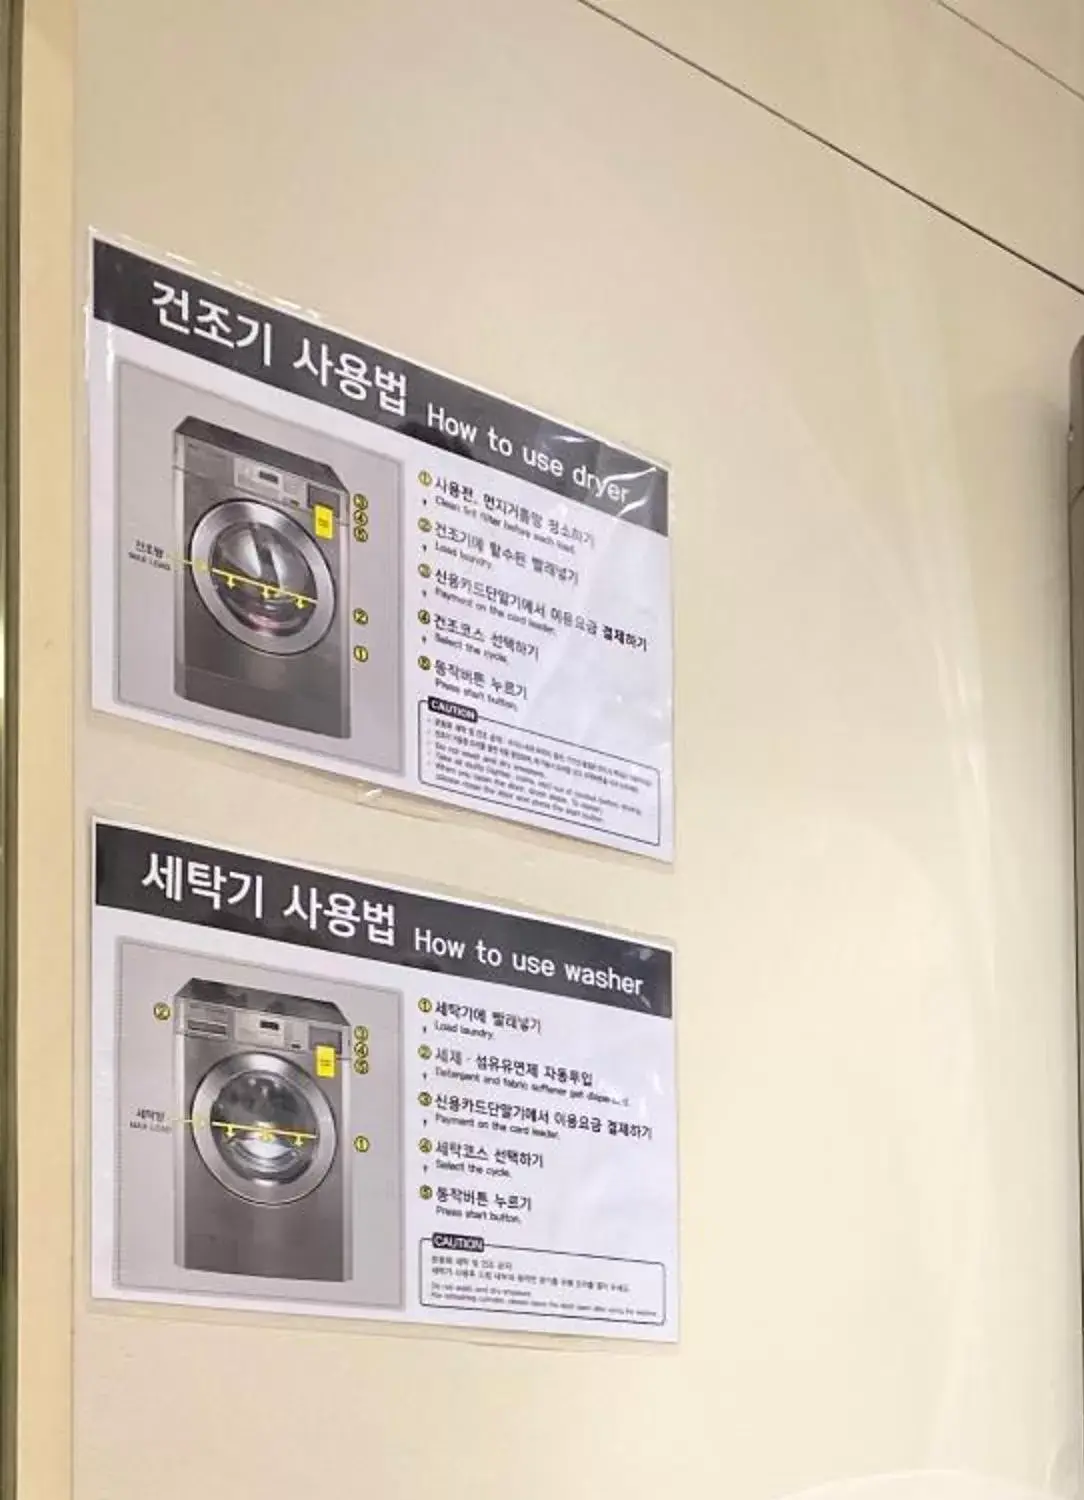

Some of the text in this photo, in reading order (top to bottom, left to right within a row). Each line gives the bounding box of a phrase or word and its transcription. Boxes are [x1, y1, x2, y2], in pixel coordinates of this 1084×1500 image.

[152, 281, 630, 503] 건조기 사용법 How to use dryer
[429, 698, 476, 721] CAUTION
[142, 852, 643, 995] 세탁기 사용법 How to use washer
[435, 1093, 549, 1126] 신용카드단말기에서
[553, 1111, 602, 1133] 이용요금
[607, 1119, 652, 1140] 결제하기
[494, 1149, 543, 1169] 선택하기
[436, 1186, 488, 1207] 동작버튼
[494, 1194, 532, 1211] 누르기
[433, 1234, 483, 1251] CAUTION
